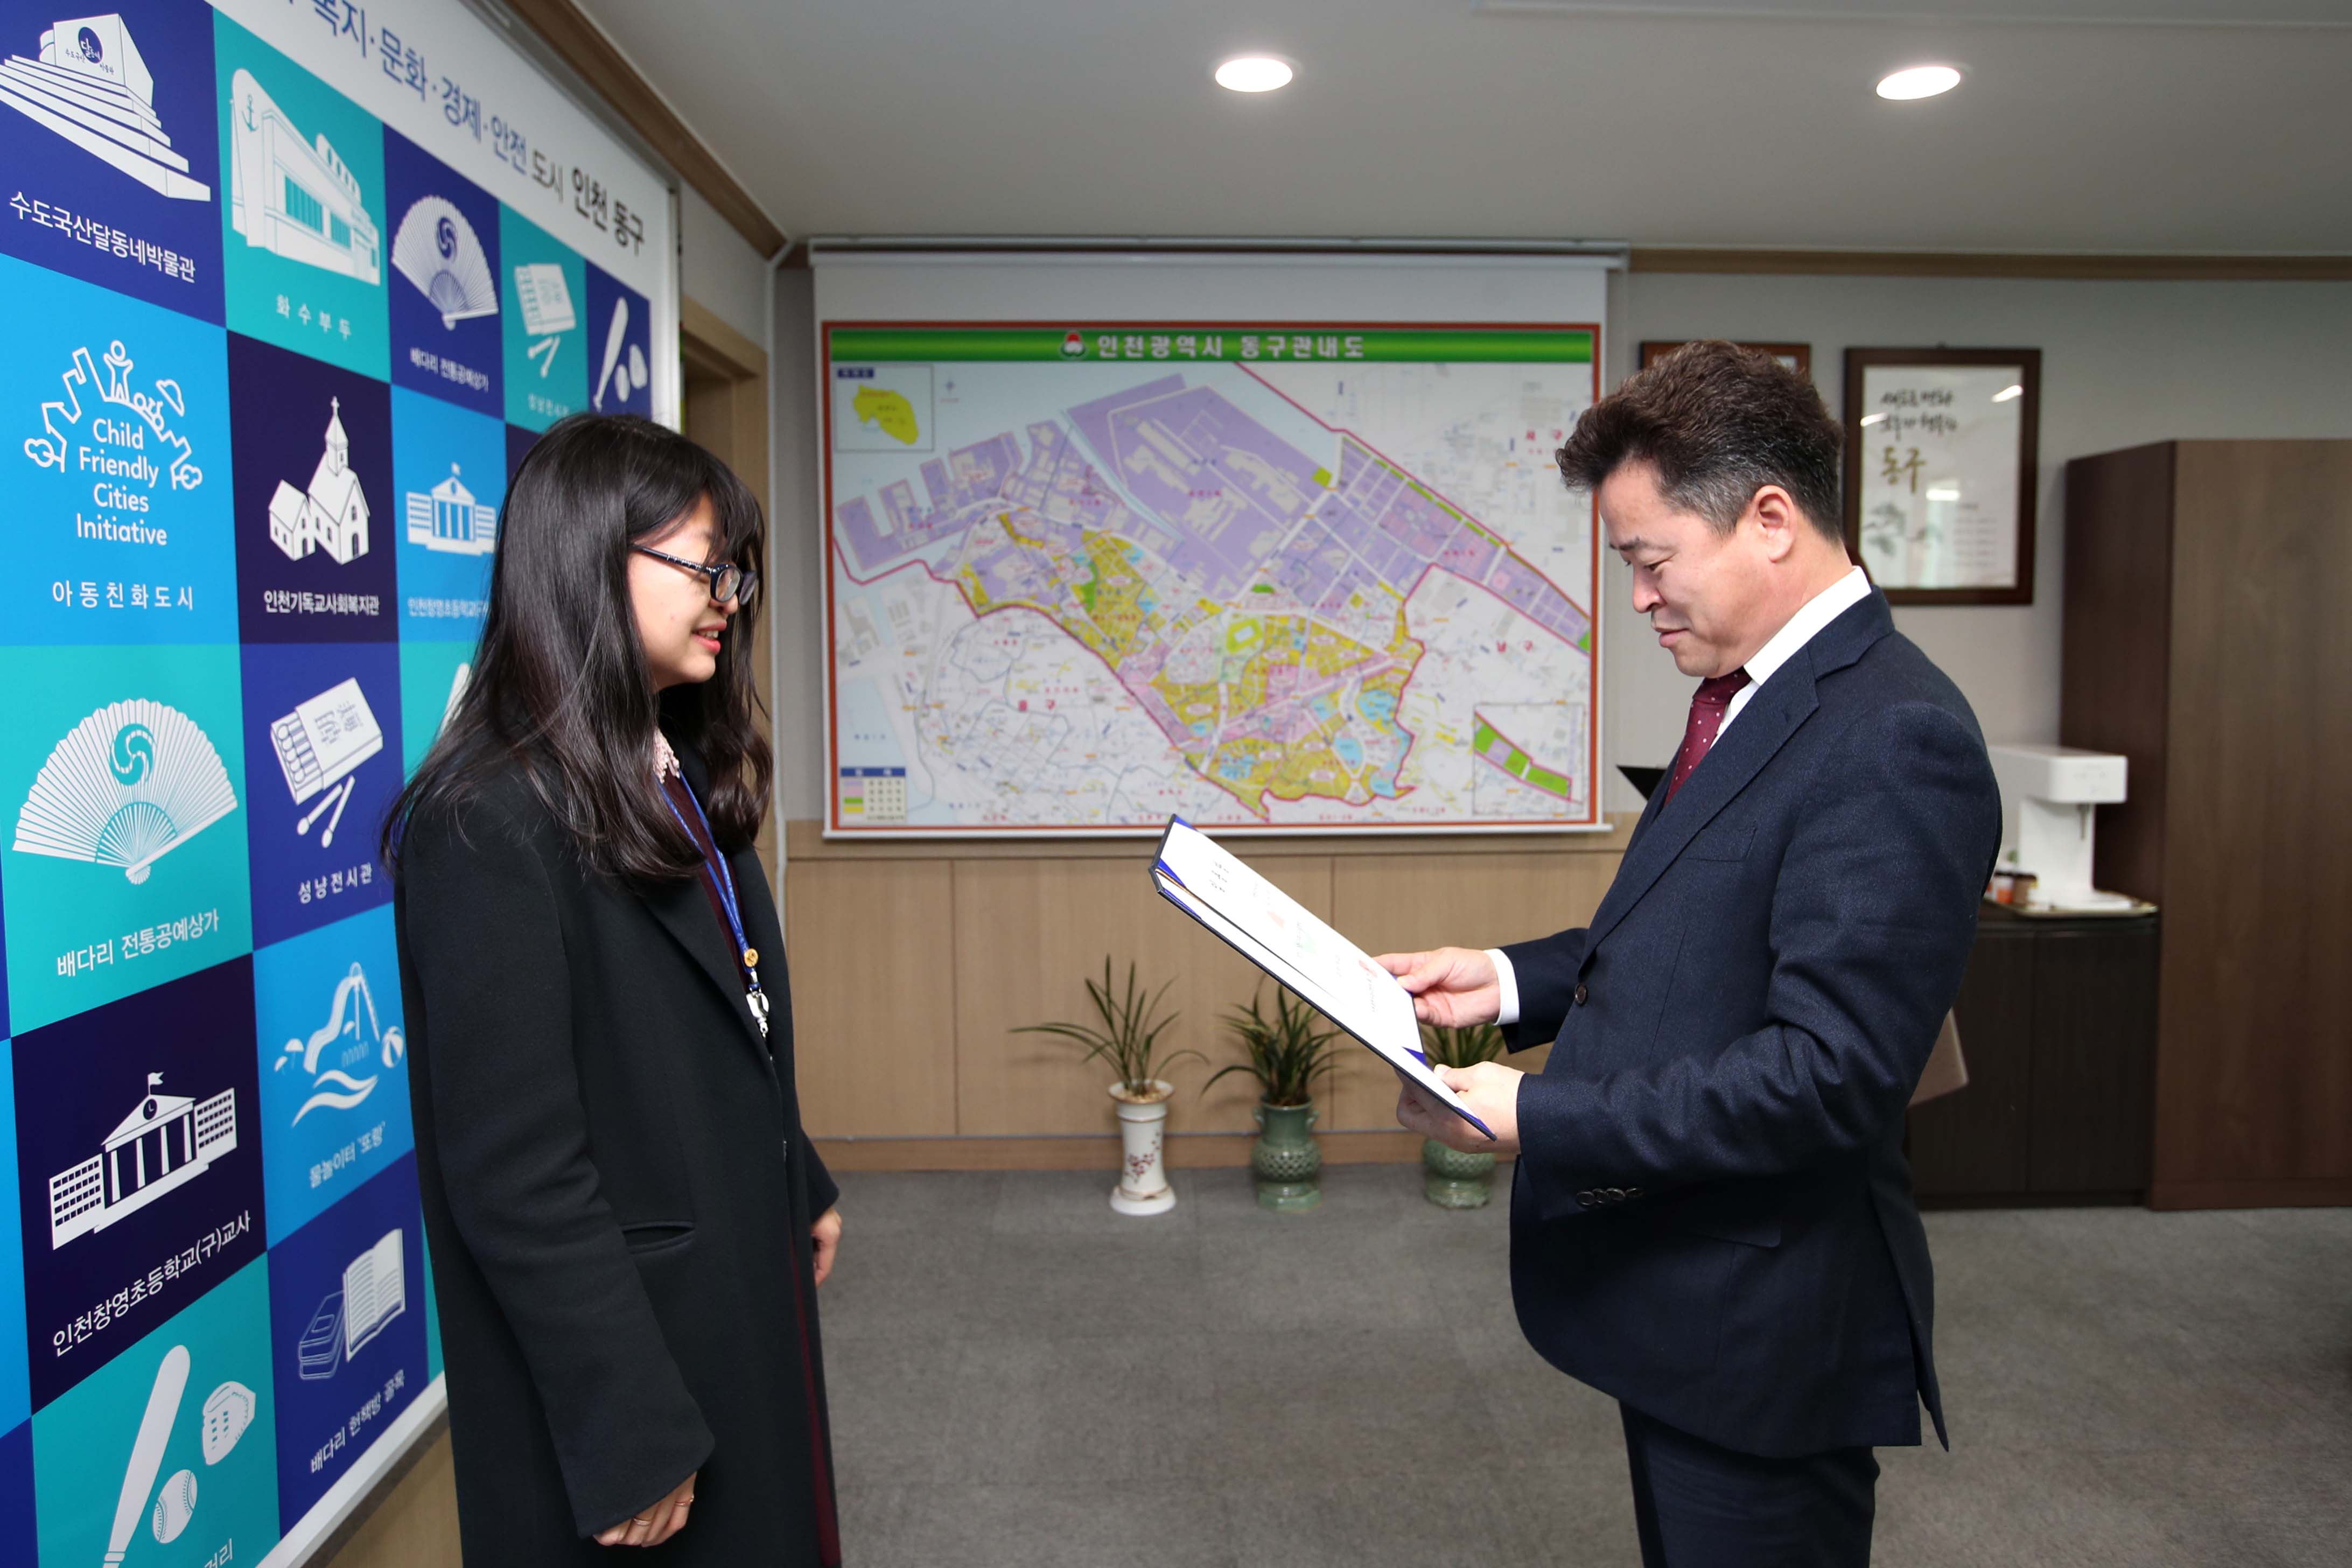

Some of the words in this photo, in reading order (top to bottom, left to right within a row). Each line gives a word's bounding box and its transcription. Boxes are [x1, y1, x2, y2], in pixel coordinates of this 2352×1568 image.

[533, 151, 563, 202] 도시
[573, 167, 607, 232] 인천
[614, 201, 644, 255] 동구
[10, 191, 195, 283] 수도국산달동네박물관
[1097, 335, 1223, 358] 인천광역시
[1240, 335, 1364, 359] 동구관내도
[93, 418, 143, 450] Child
[79, 447, 159, 488] Friendly
[1881, 445, 1927, 494] 동구
[93, 483, 149, 513] Cities
[76, 513, 167, 546] Initiative
[264, 590, 379, 616] 인천기독교사회복지관
[298, 862, 372, 904] 성냥전시관
[57, 939, 114, 977] 배다리
[121, 908, 219, 959] 전통공예상가
[53, 1210, 251, 1357] 인천창영초등학교(구)교사
[310, 1426, 346, 1474] 배다리
[349, 1392, 381, 1437] 헌책방
